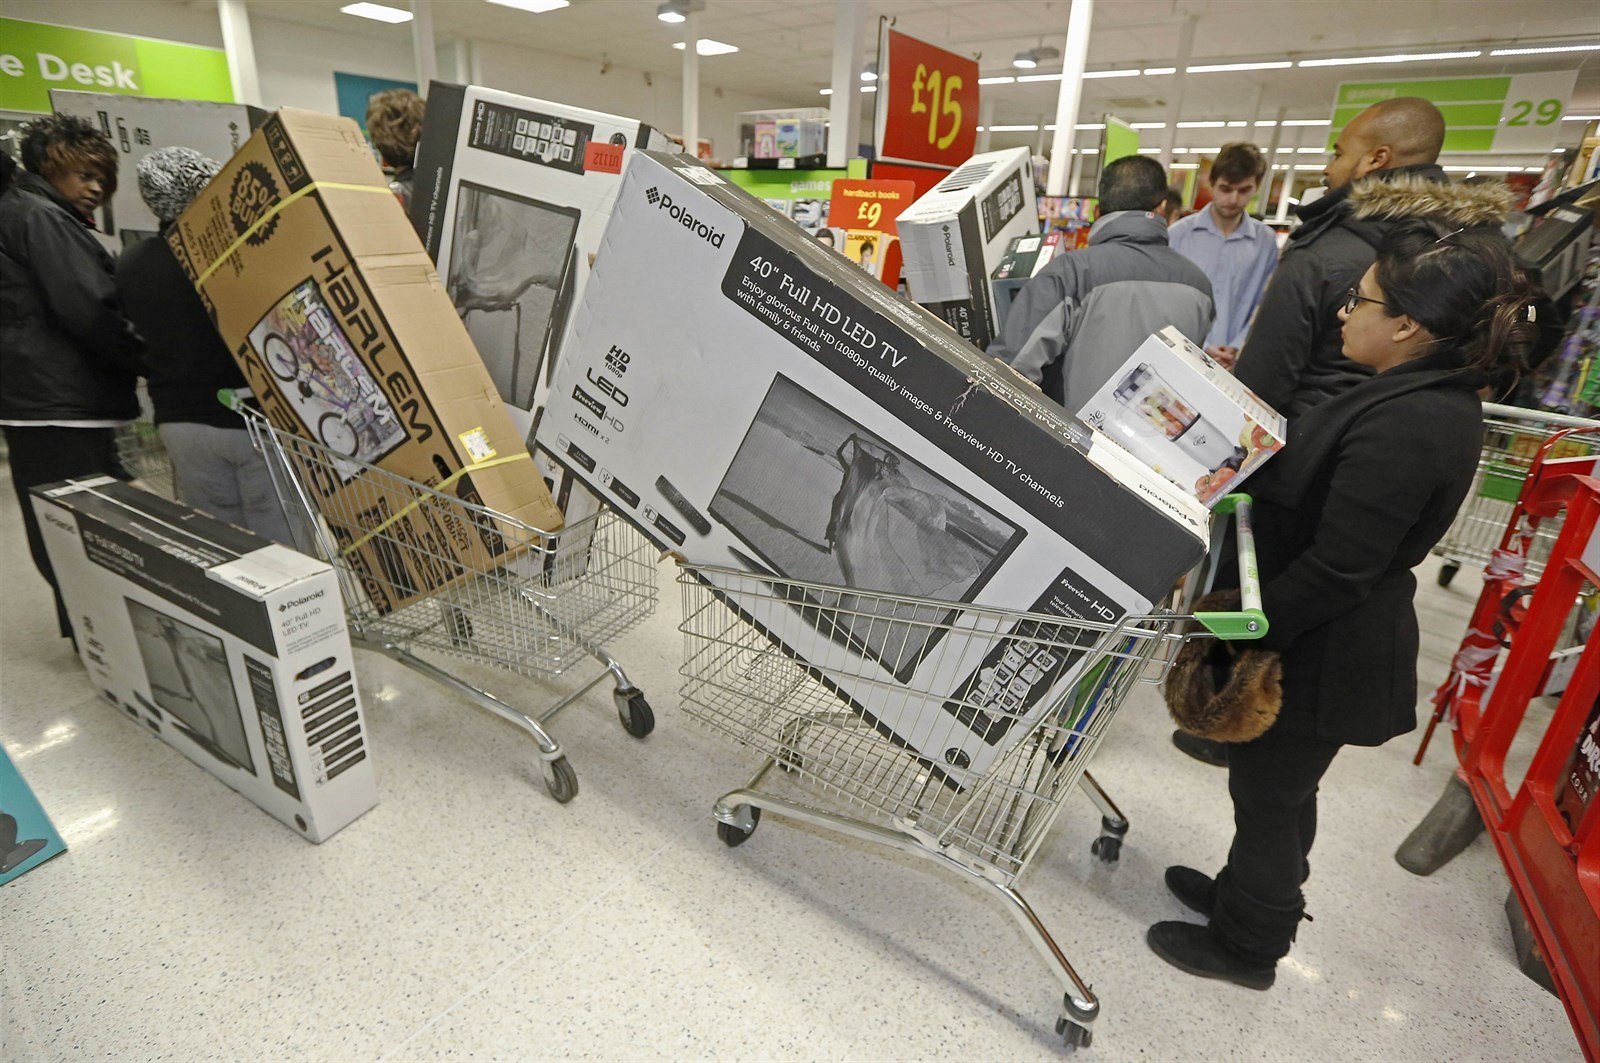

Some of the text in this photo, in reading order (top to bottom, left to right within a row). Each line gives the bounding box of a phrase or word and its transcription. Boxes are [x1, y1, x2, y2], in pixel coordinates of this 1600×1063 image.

[36, 52, 139, 91] Desk
[911, 63, 962, 150] £15
[1506, 99, 1563, 127] 29
[790, 180, 831, 193] games
[843, 188, 900, 199] hardback books
[659, 193, 725, 249] Polaroid
[857, 201, 882, 228] £9
[943, 232, 956, 266] Polaroid
[736, 287, 822, 353] with family & friends
[750, 256, 908, 368] 40" Full HD LED TV
[962, 321, 971, 336] Full
[609, 345, 631, 364] HD
[604, 361, 624, 379] 1080p
[970, 369, 987, 382] TV
[586, 367, 629, 407] LED
[741, 275, 1065, 508] Enjoy glorious Full HD (1080p) quality images & Freeview HD TV channels
[989, 382, 1013, 399] LED
[575, 388, 625, 433] Freeview HD
[1014, 398, 1033, 414] HD
[1035, 413, 1056, 430] Full
[1139, 484, 1187, 520] Polaroid
[286, 589, 324, 609] Polaroid
[1061, 578, 1115, 621] Freeview HD
[295, 611, 308, 623] Full
[309, 607, 321, 616] HD
[1064, 603, 1086, 620] favourit
[282, 621, 309, 637] LED TV
